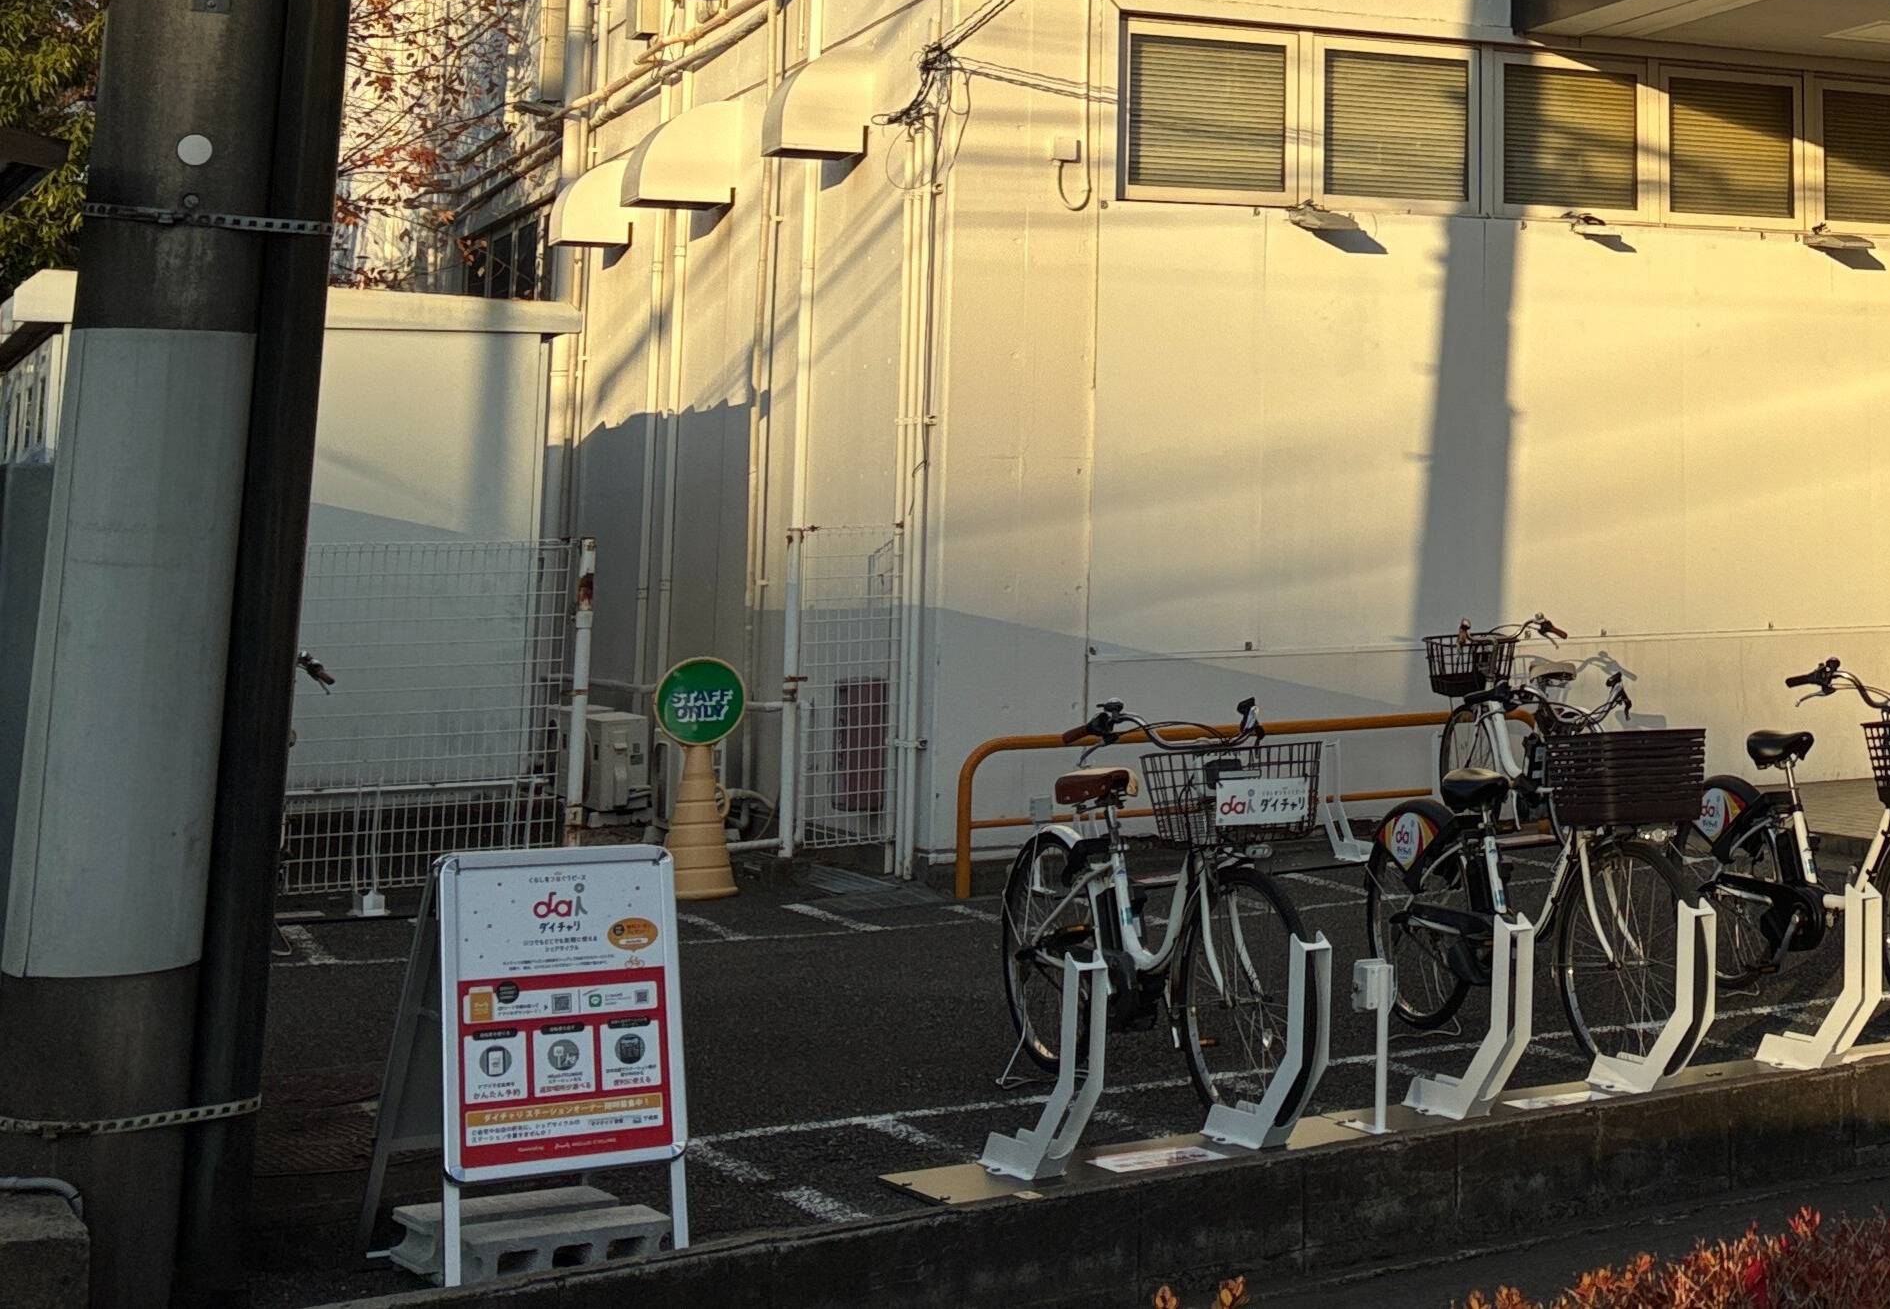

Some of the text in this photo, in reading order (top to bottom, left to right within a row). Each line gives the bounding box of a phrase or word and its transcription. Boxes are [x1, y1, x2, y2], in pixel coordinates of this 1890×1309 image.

[672, 689, 734, 707] STAFF
[677, 703, 729, 723] ONLY
[1260, 796, 1305, 812] ダイチャリ
[533, 883, 588, 918] dai
[539, 921, 580, 933] ダイチャリ
[473, 1088, 521, 1100] かんたん予約
